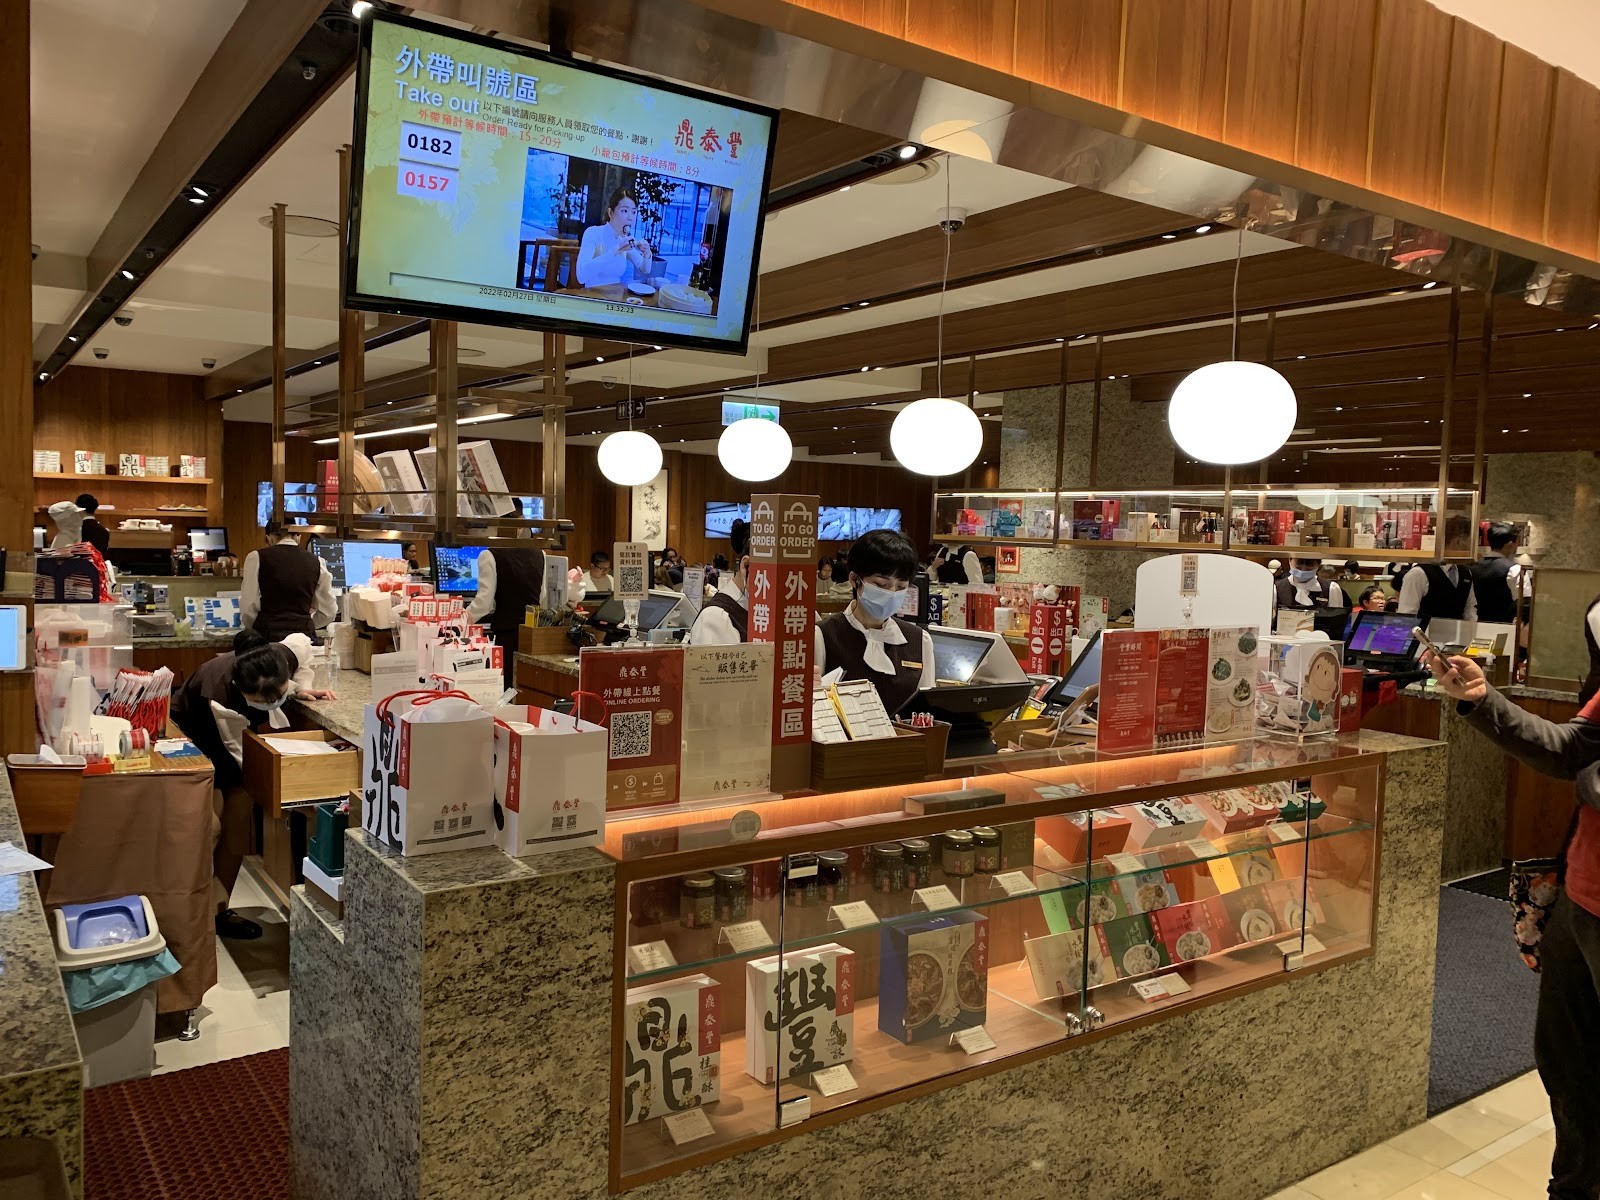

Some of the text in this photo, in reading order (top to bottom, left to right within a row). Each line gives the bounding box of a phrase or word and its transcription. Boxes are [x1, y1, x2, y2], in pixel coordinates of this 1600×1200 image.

[394, 43, 540, 106] 外帶叫號區
[394, 79, 480, 115] Take out
[482, 112, 505, 126] Order
[506, 117, 535, 133] Ready
[534, 123, 545, 133] for
[674, 118, 743, 158] 鼎泰豐
[407, 133, 453, 156] 0182
[404, 171, 450, 192] 0157
[478, 287, 557, 304] 2022年02月27日 星期日
[605, 304, 635, 314] 13:32:23
[752, 523, 775, 534] TO GO
[782, 524, 814, 535] TO GO
[751, 537, 776, 547] ORDER
[780, 537, 815, 548] ORDER
[927, 612, 940, 621] 入口
[1031, 626, 1045, 636] 出口
[1050, 627, 1063, 637] 出口
[700, 652, 747, 661] 以下餐點今日已
[780, 570, 808, 738] 外帶點餐區
[603, 685, 661, 699] 外帶線上點餐
[628, 696, 661, 705] ORDERING
[704, 993, 717, 1045] 鼎泰豐
